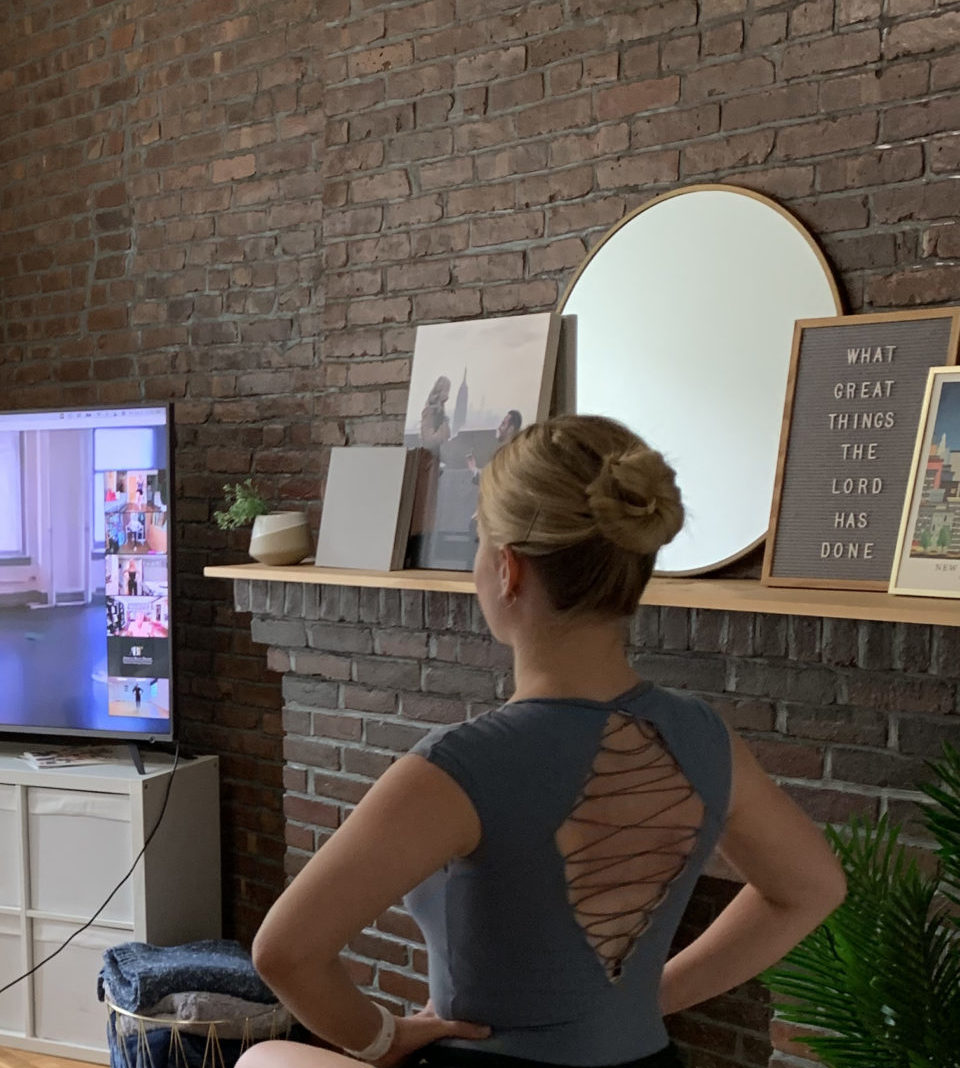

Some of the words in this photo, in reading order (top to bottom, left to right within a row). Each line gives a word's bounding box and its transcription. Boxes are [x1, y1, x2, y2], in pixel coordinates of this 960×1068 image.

[847, 345, 896, 365] WHAT
[833, 380, 895, 400] GREAT
[828, 411, 895, 430] THINGS
[841, 443, 878, 460] THE
[831, 477, 882, 495] LORD
[833, 512, 868, 529] HAS
[820, 542, 874, 559] DONE
